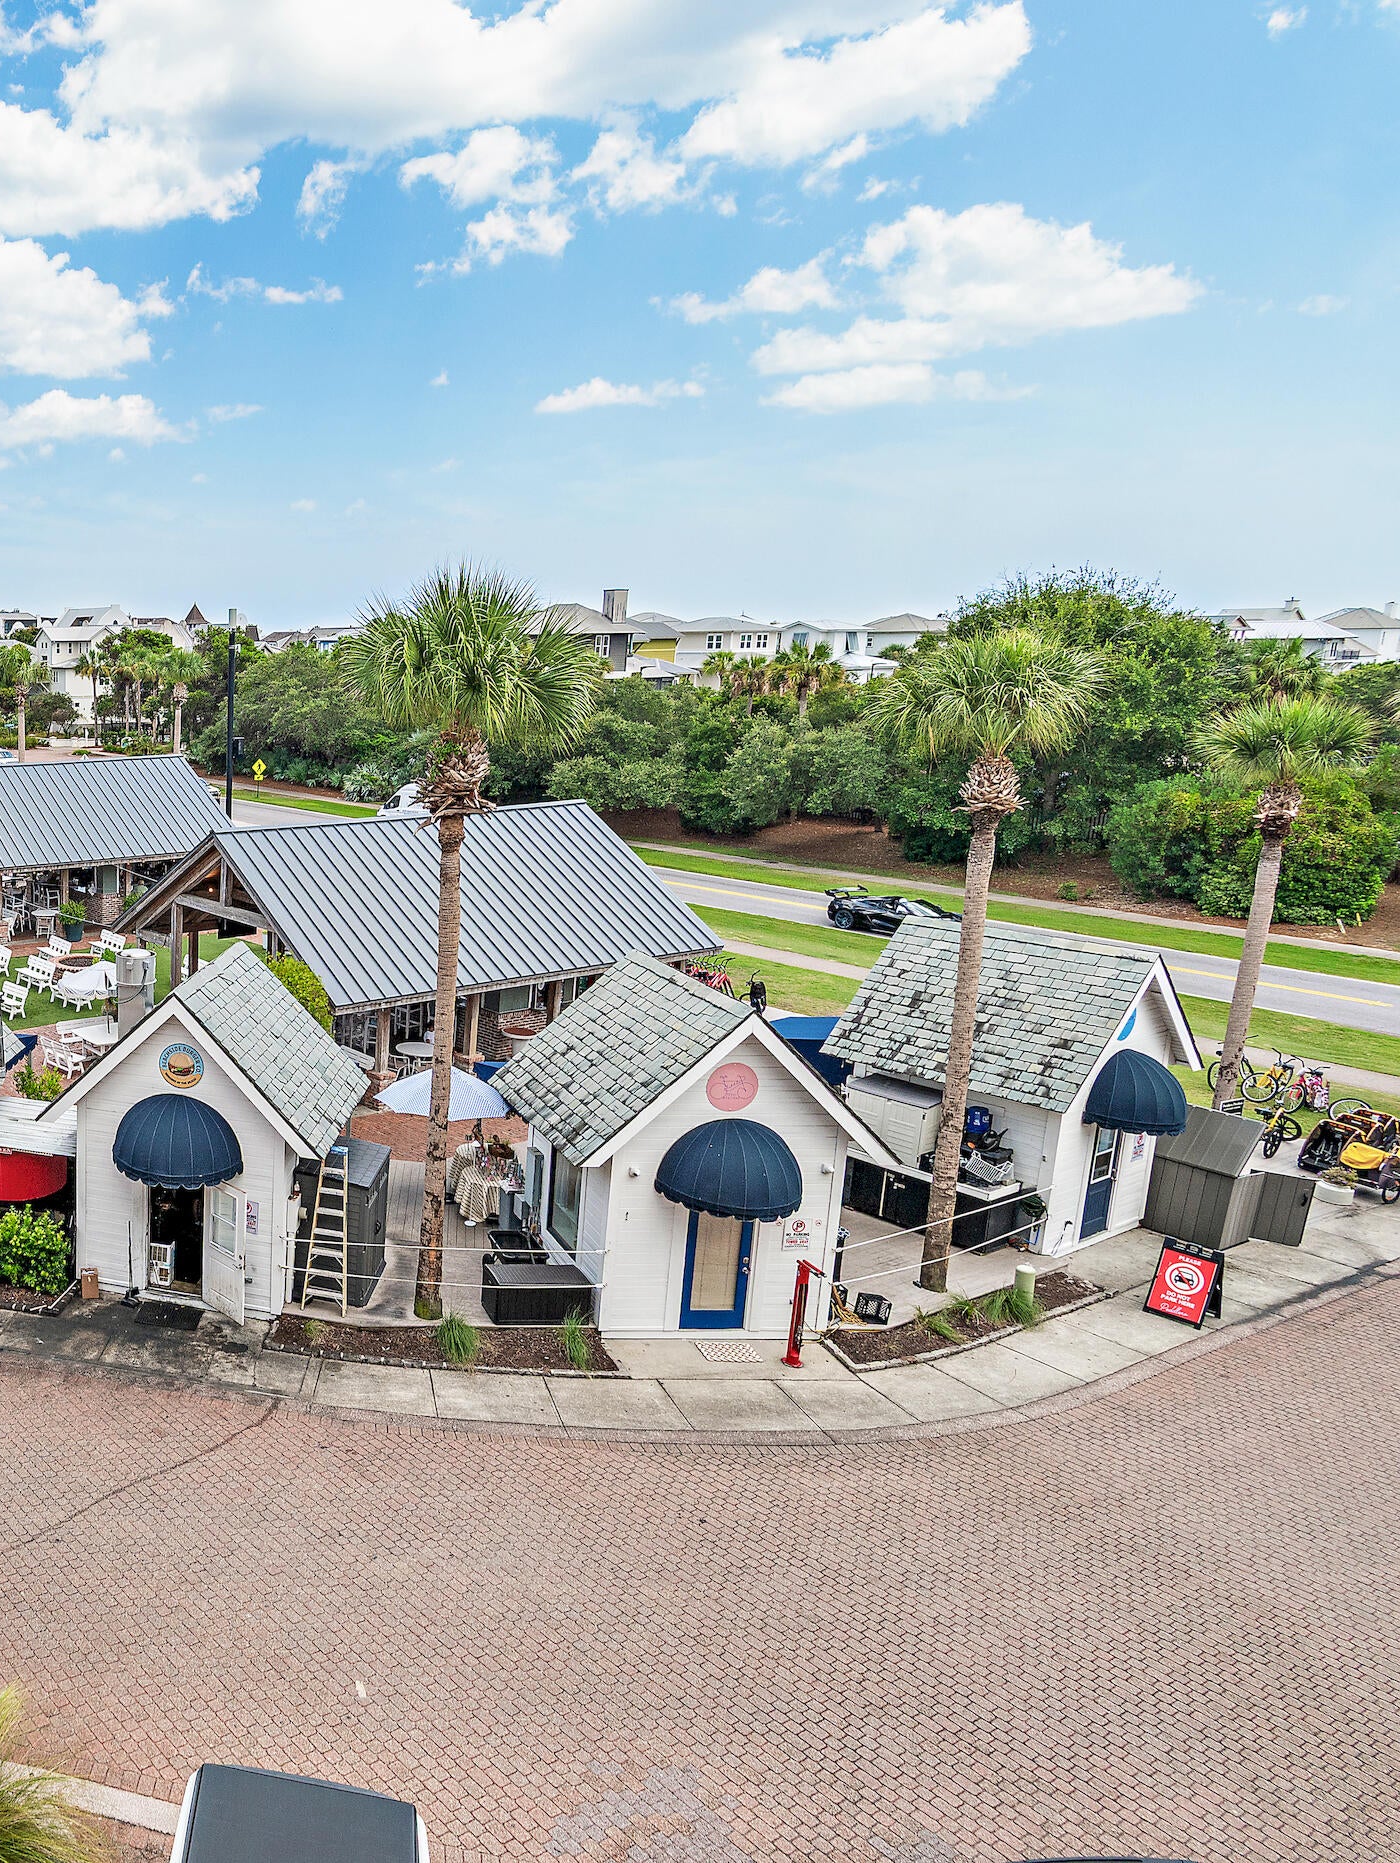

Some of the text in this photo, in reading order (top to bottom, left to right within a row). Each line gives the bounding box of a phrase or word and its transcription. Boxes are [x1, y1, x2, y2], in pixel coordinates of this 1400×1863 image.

[161, 1046, 182, 1068] BEACHSIDE
[182, 1046, 201, 1064] BURGER
[1178, 1255, 1202, 1266] PLEASE
[1160, 1293, 1196, 1310] PARK HERE
[1166, 1290, 1192, 1302] DO NOT
